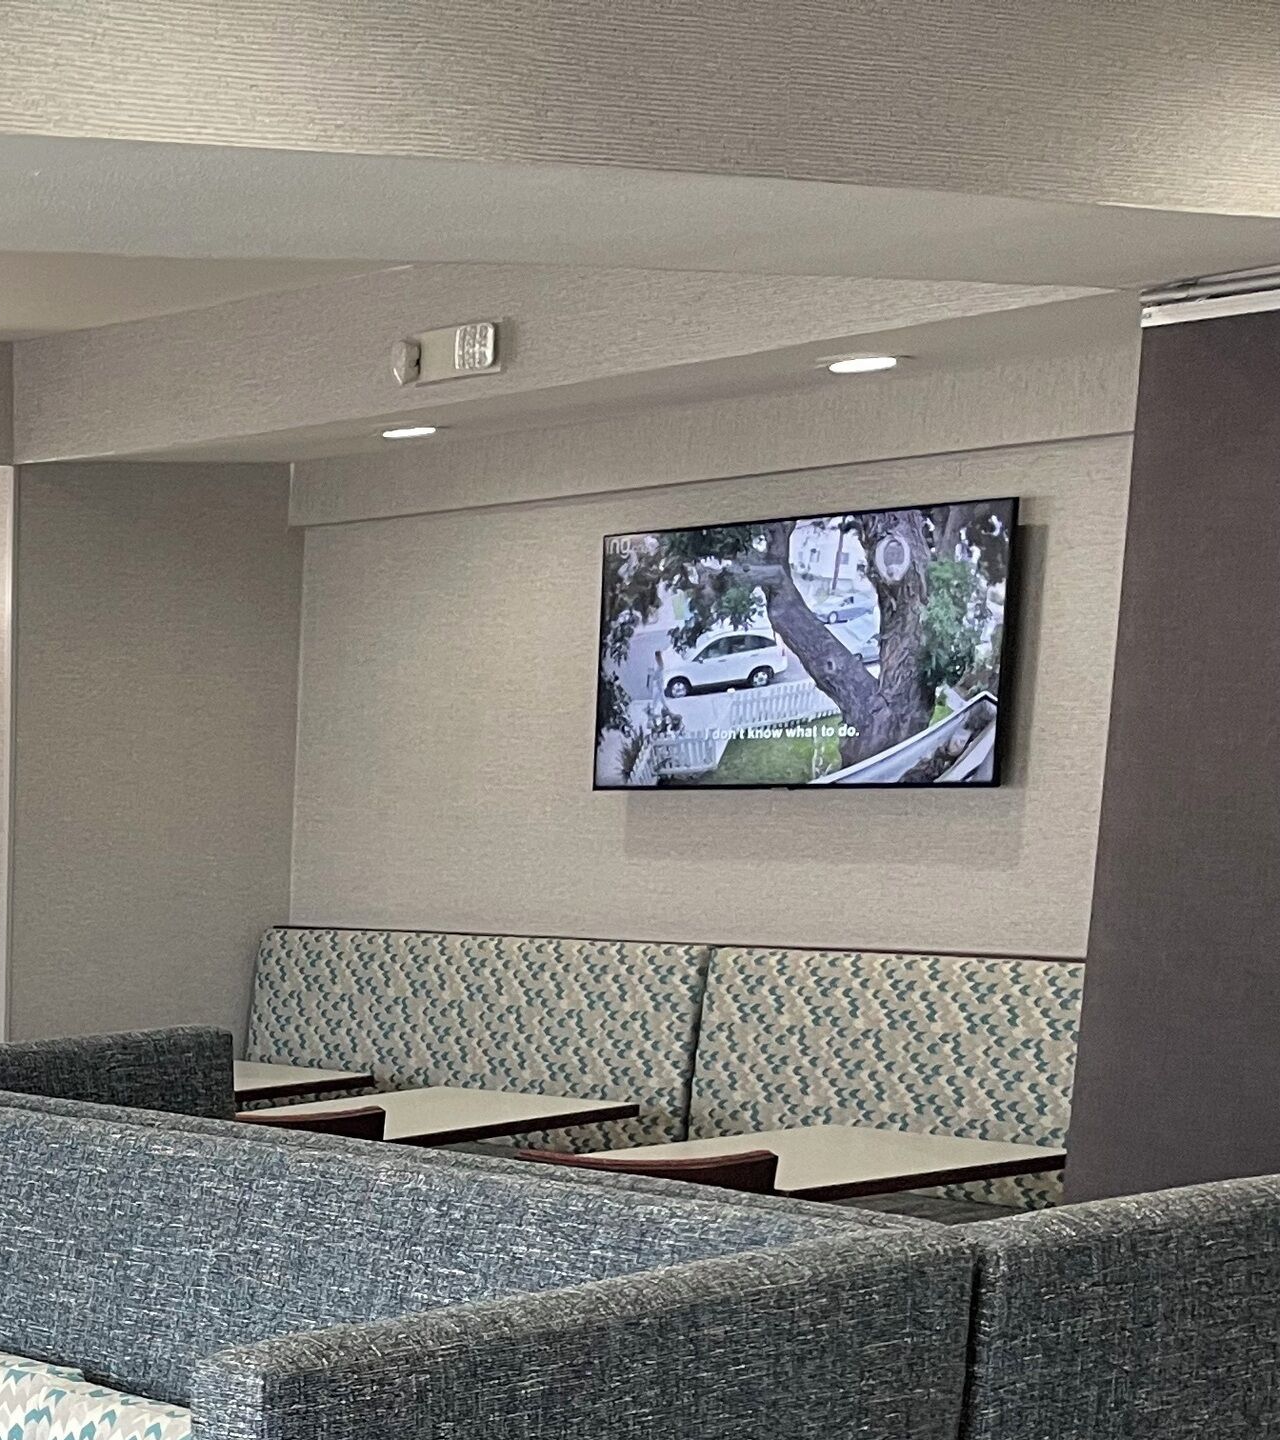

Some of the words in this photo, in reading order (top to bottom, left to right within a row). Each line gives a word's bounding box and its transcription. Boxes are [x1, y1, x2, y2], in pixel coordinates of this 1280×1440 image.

[712, 727, 744, 740] don't
[747, 726, 783, 739] know
[786, 725, 817, 738] what
[821, 725, 835, 737] to
[838, 724, 860, 737] do.
